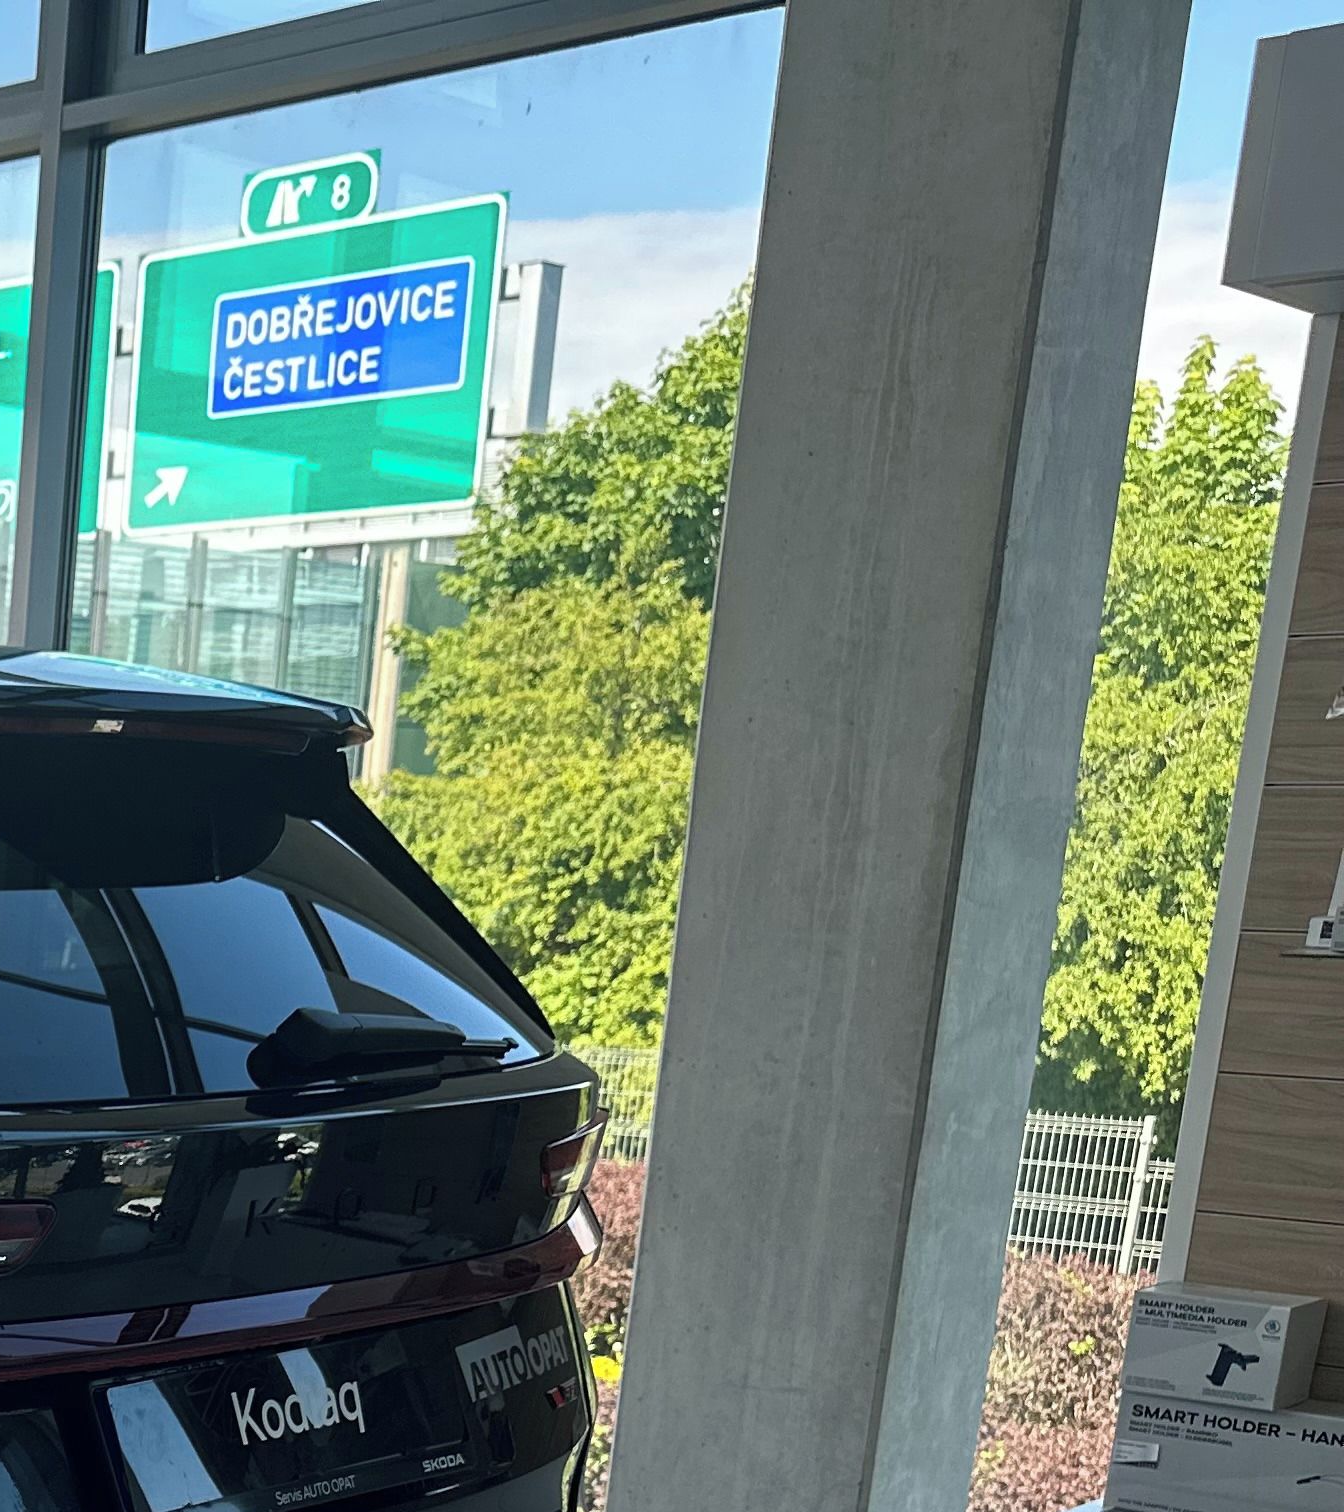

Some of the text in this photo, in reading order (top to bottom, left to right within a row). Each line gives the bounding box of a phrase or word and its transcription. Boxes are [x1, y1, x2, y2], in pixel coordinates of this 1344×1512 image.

[330, 173, 352, 211] 8
[225, 280, 457, 349] DOBŘEJOVICE
[223, 346, 381, 400] ČESTLICE
[230, 1380, 366, 1446] Kodaq
[1131, 1403, 1200, 1425] SMART
[1203, 1413, 1281, 1438] HOLDER
[275, 1474, 356, 1506] Servis AUTO OPAT
